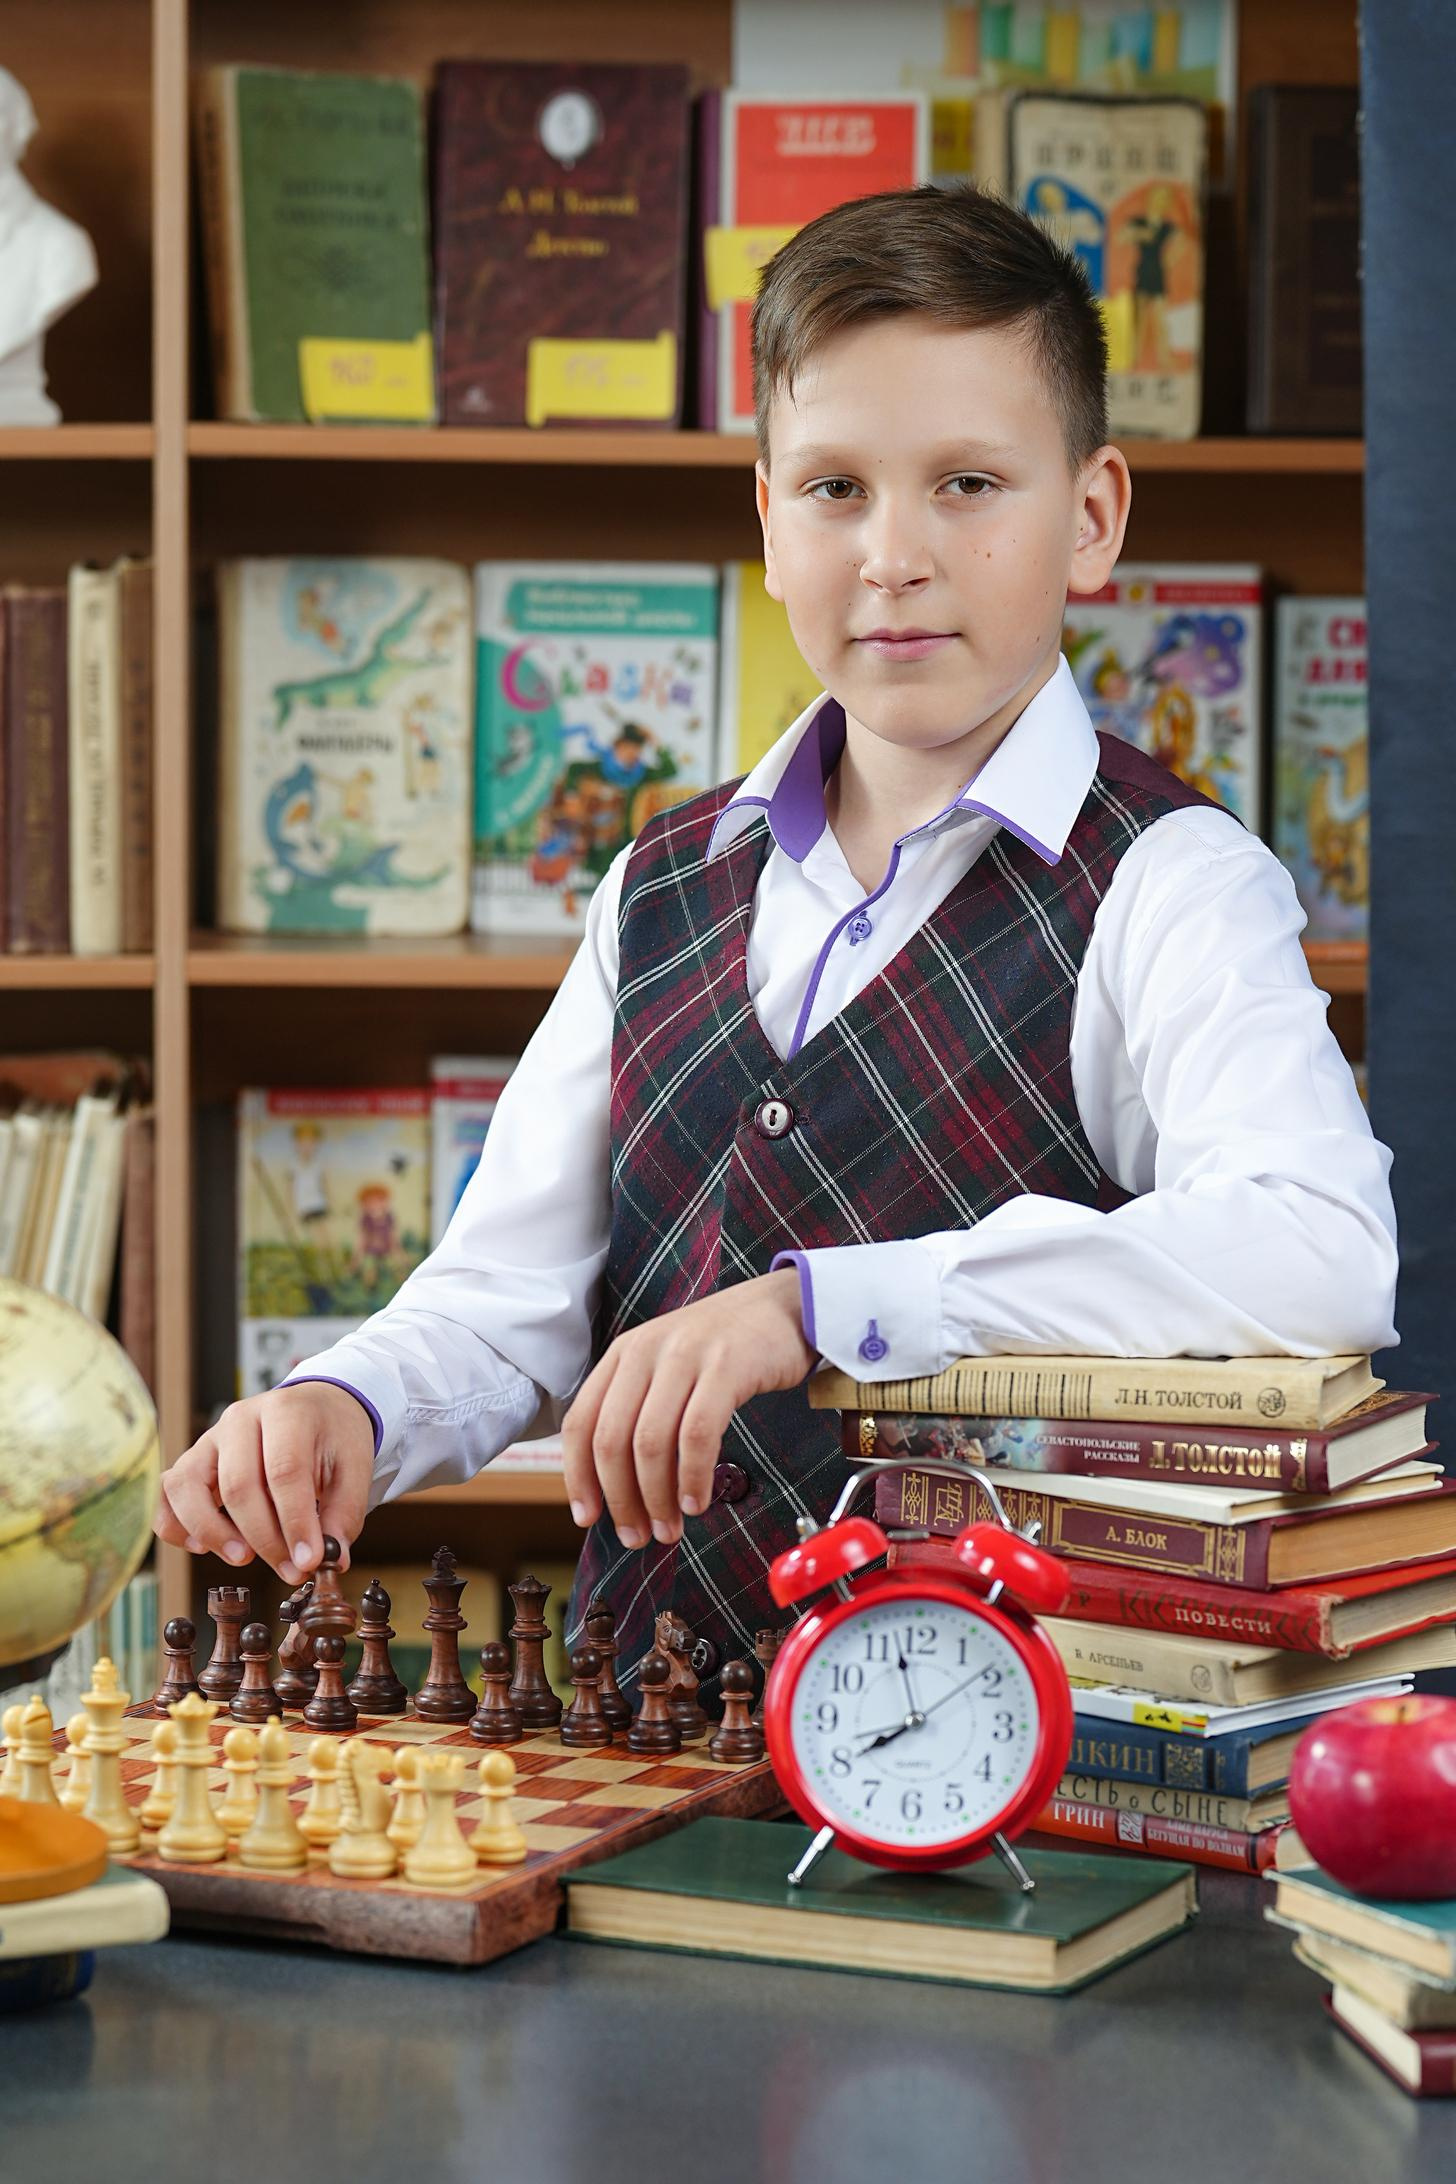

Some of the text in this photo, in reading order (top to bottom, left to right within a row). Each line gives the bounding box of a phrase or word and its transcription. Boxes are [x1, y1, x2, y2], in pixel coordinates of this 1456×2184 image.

[1155, 1390, 1243, 1410] ТОЛСТОЙ
[1036, 1435, 1141, 1452] СЕВАСТОПОЛЬСКИЕ
[1083, 1450, 1140, 1464] РАССКАЗЫ
[1172, 1442, 1283, 1479] ТОЛСТОЙ
[1105, 1525, 1168, 1551] А. БЛОК
[1174, 1607, 1273, 1635] ПОВЕСТИ
[864, 1633, 890, 1662] 11
[904, 1624, 938, 1655] 12
[957, 1637, 967, 1665] 1
[1088, 1651, 1145, 1673] АРСЕНЬЕВ
[831, 1663, 864, 1694] 10
[981, 1668, 1003, 1699] 2
[816, 1701, 839, 1735] 9
[992, 1710, 1014, 1743] 3
[829, 1744, 852, 1779] 8
[974, 1752, 993, 1783] 4
[862, 1779, 881, 1809] 7
[900, 1789, 923, 1822] 6
[944, 1783, 965, 1813] 5
[1150, 1788, 1228, 1827] СЫНЕ
[1053, 1801, 1105, 1830] ГРИН
